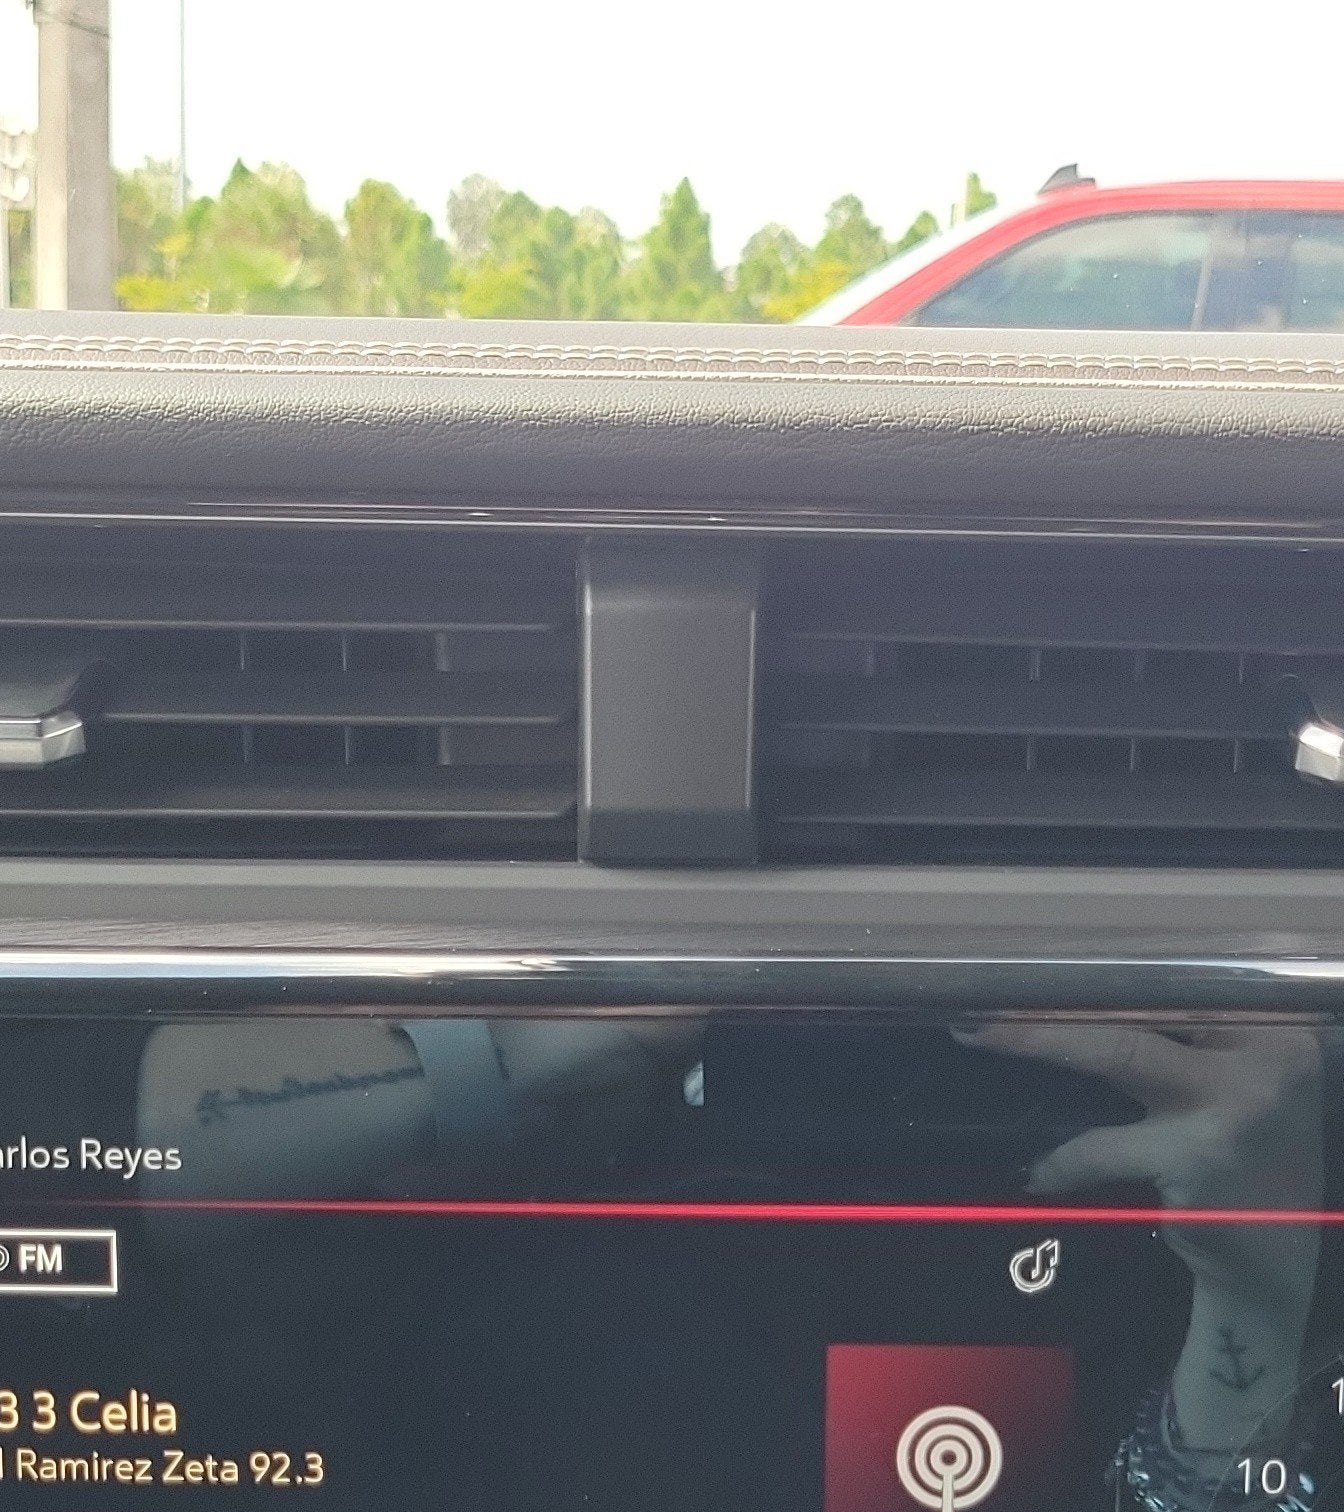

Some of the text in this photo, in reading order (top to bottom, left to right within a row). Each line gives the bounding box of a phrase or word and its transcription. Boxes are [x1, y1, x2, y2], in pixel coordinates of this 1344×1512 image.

[80, 1138, 182, 1180] Reyes
[19, 1243, 63, 1272] FM
[32, 1390, 57, 1432] 3
[70, 1389, 177, 1433] Celia
[16, 1448, 154, 1482] Ramirez
[162, 1450, 239, 1483] Zeta
[249, 1451, 324, 1484] 92.3
[1237, 1458, 1286, 1495] 10
